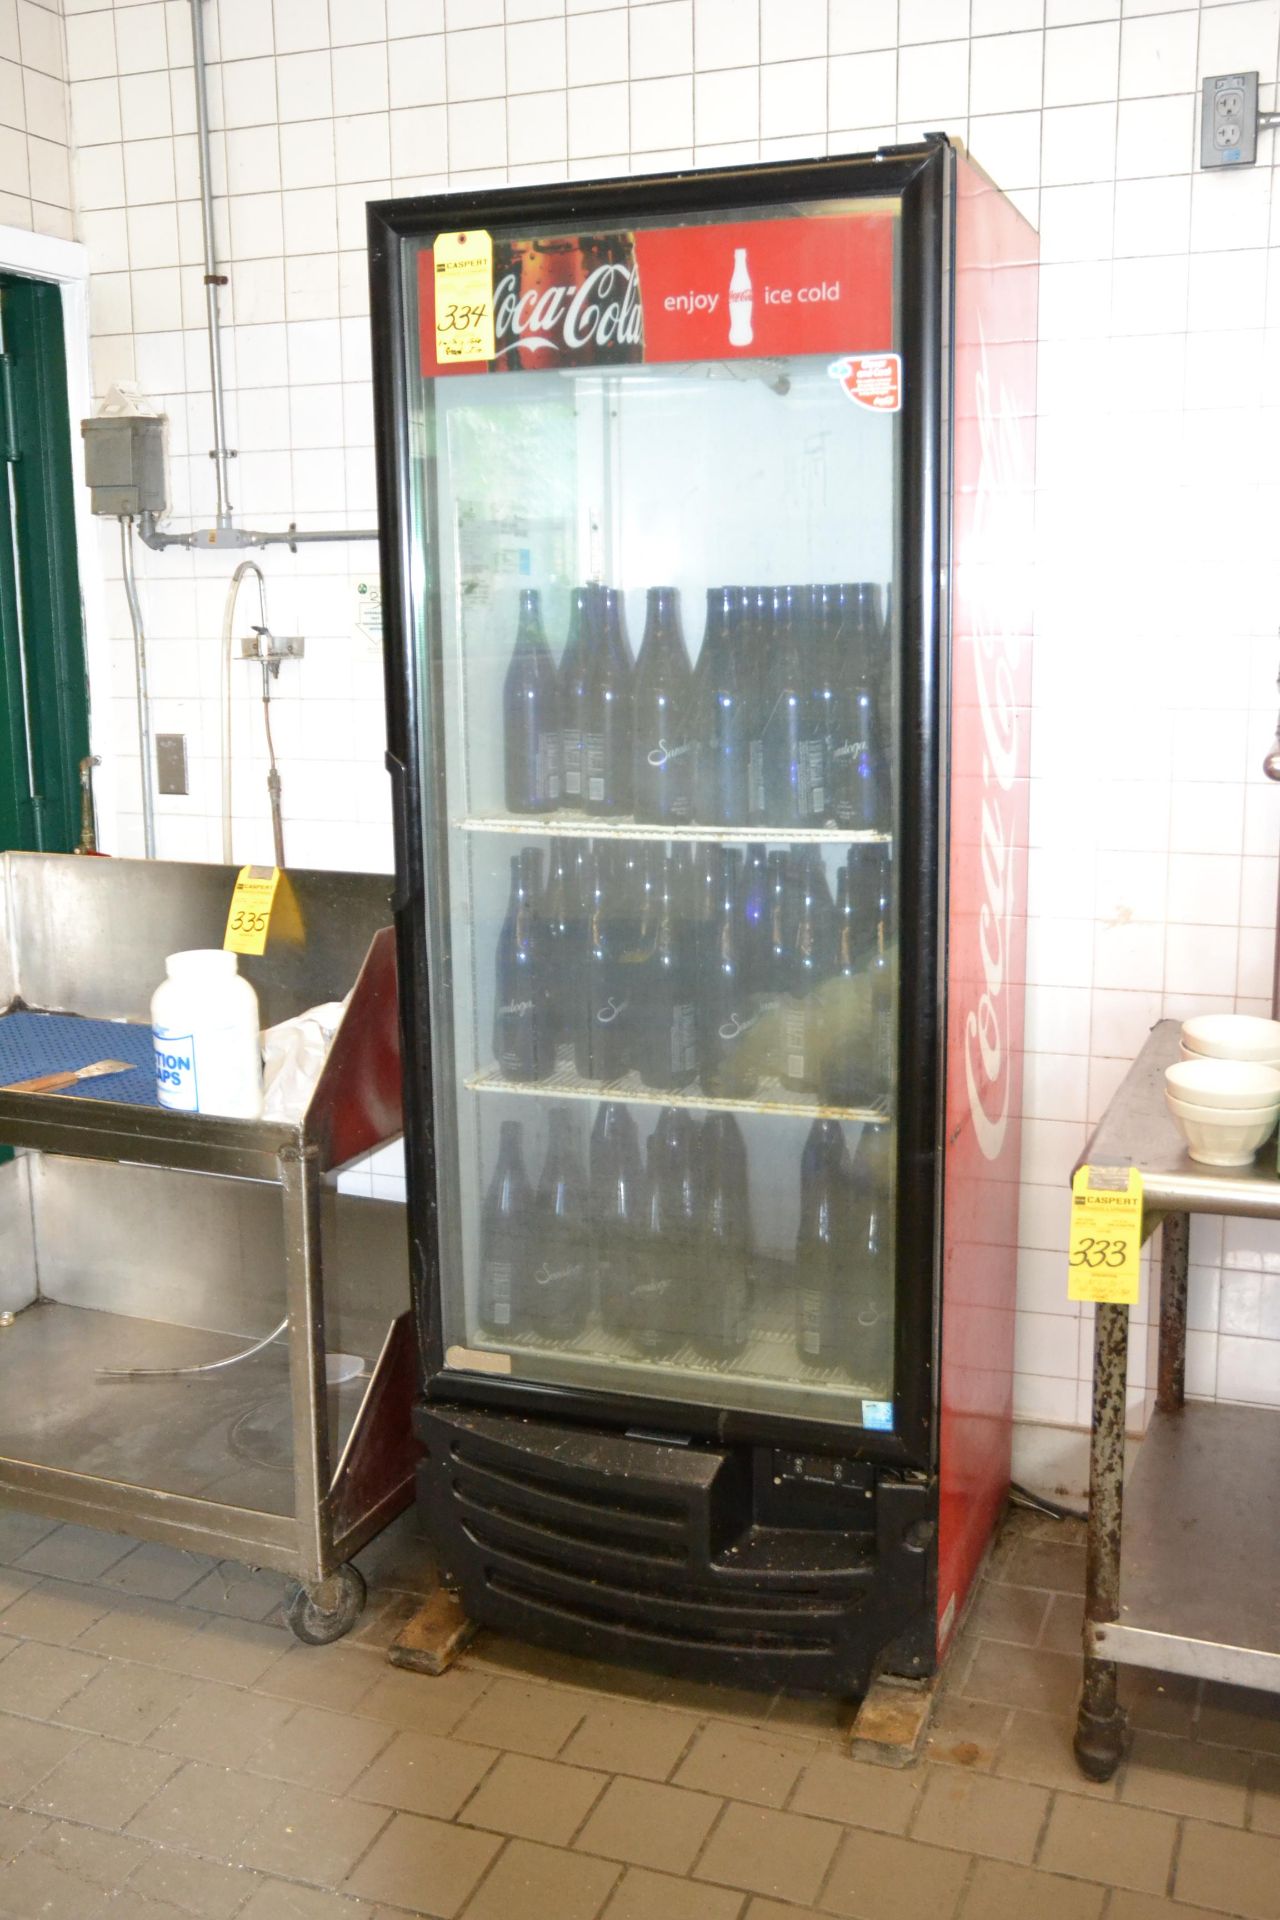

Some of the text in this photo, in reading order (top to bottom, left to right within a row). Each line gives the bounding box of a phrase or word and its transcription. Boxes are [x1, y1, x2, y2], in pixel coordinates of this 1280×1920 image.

[664, 292, 719, 314] enjoy
[764, 286, 793, 305] ice
[797, 282, 840, 302] cold
[437, 303, 488, 332] 334
[965, 335, 1021, 1161] Coca-Cla
[231, 910, 270, 932] 335
[1086, 1196, 1138, 1206] CASPERT
[1069, 1238, 1127, 1268] 333
